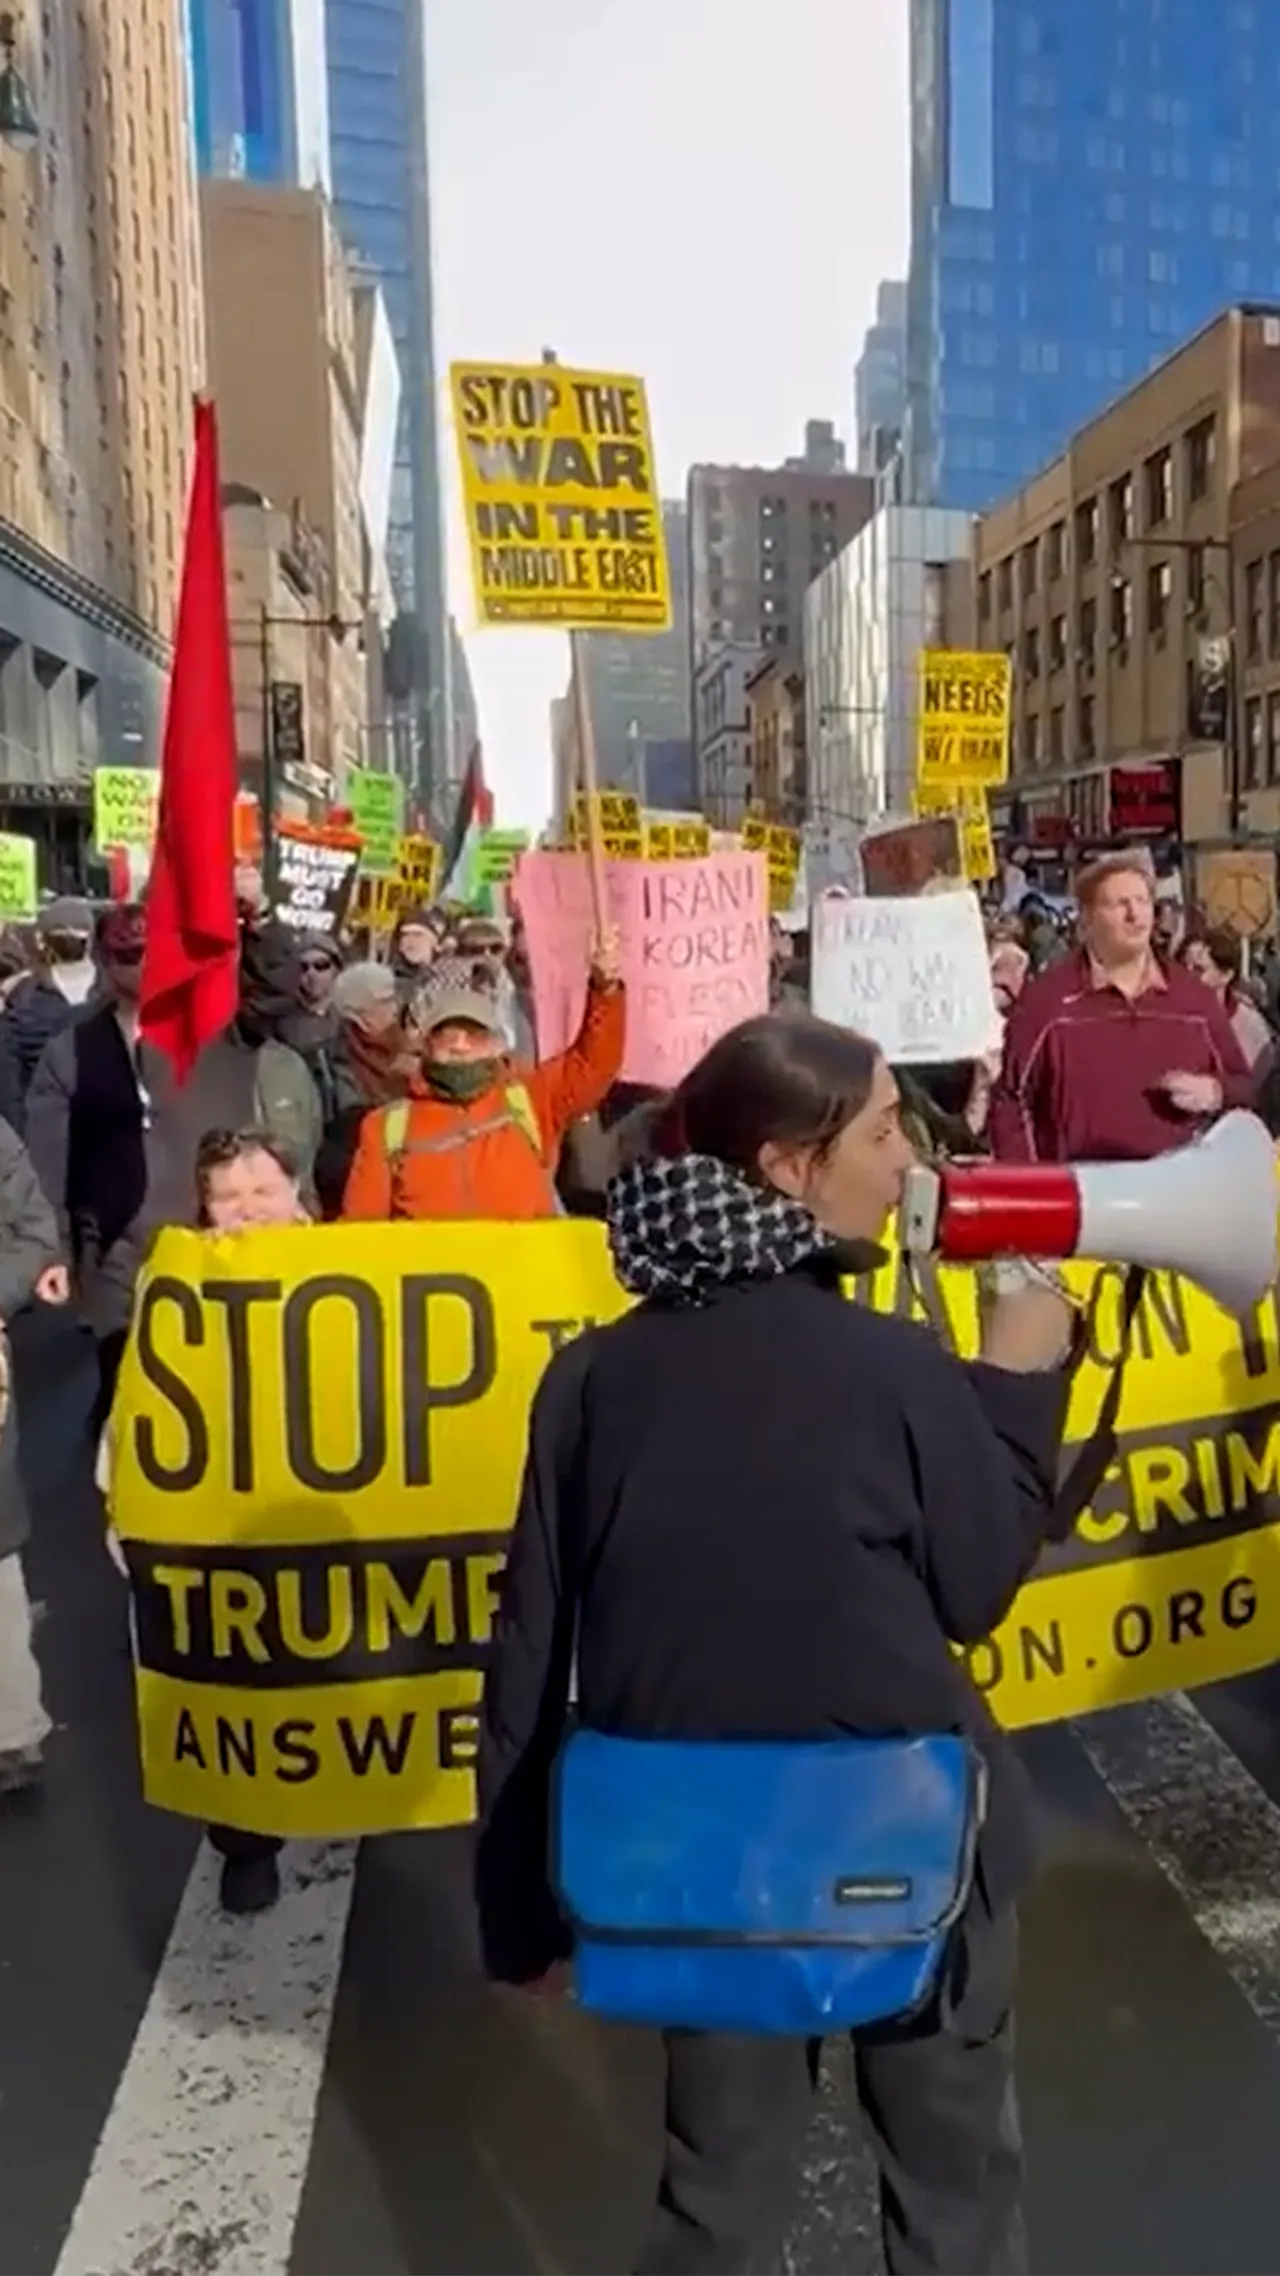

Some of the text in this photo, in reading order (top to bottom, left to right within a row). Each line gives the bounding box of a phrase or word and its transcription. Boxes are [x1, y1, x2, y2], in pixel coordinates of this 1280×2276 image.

[460, 375, 642, 436] STOP THE
[466, 433, 649, 493] WAR
[475, 502, 655, 544] IN THE
[480, 546, 658, 594] MIDDLE EAST
[925, 676, 1005, 716] NEEDS
[134, 1273, 498, 1493] STOP
